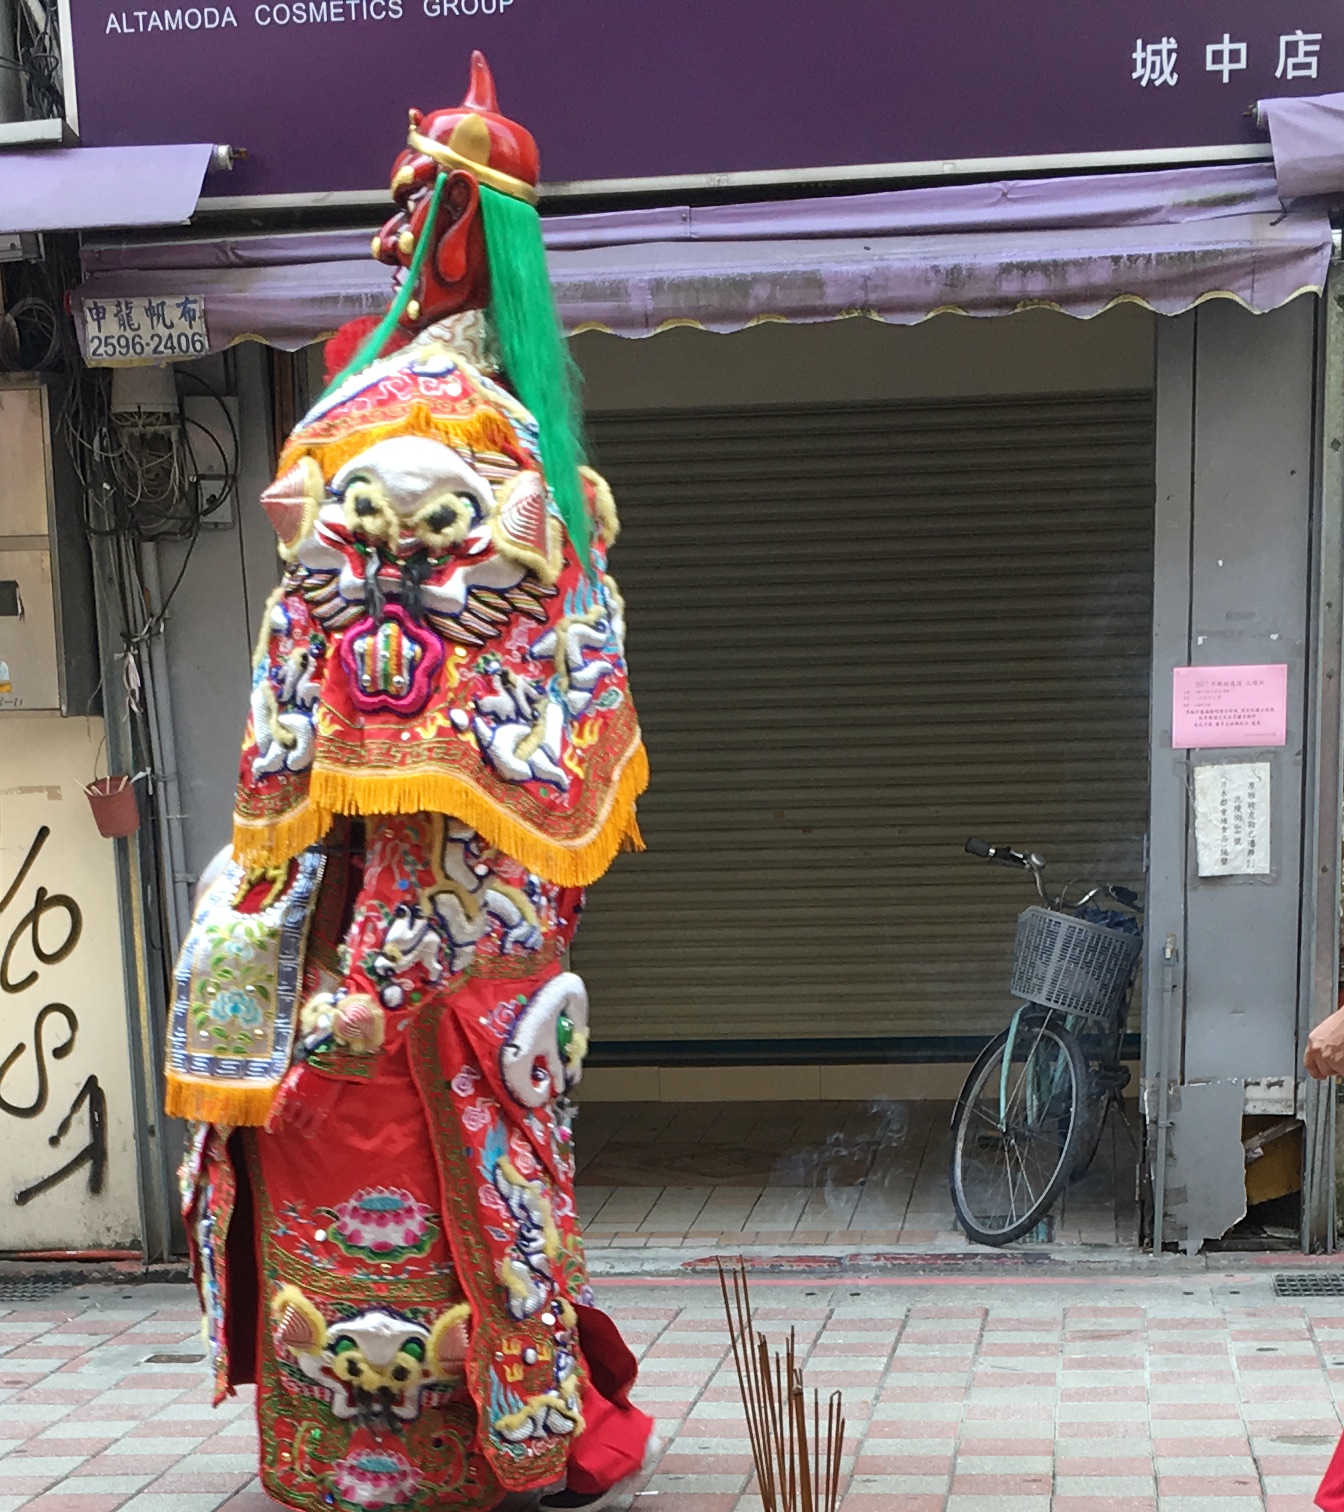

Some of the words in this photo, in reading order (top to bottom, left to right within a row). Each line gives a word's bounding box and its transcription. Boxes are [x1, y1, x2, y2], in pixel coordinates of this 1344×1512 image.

[105, 7, 238, 35] ALTAMODA
[254, 0, 404, 26] COSMETICS
[1131, 29, 1323, 87] 城中店
[87, 295, 198, 333] 申龍帆布
